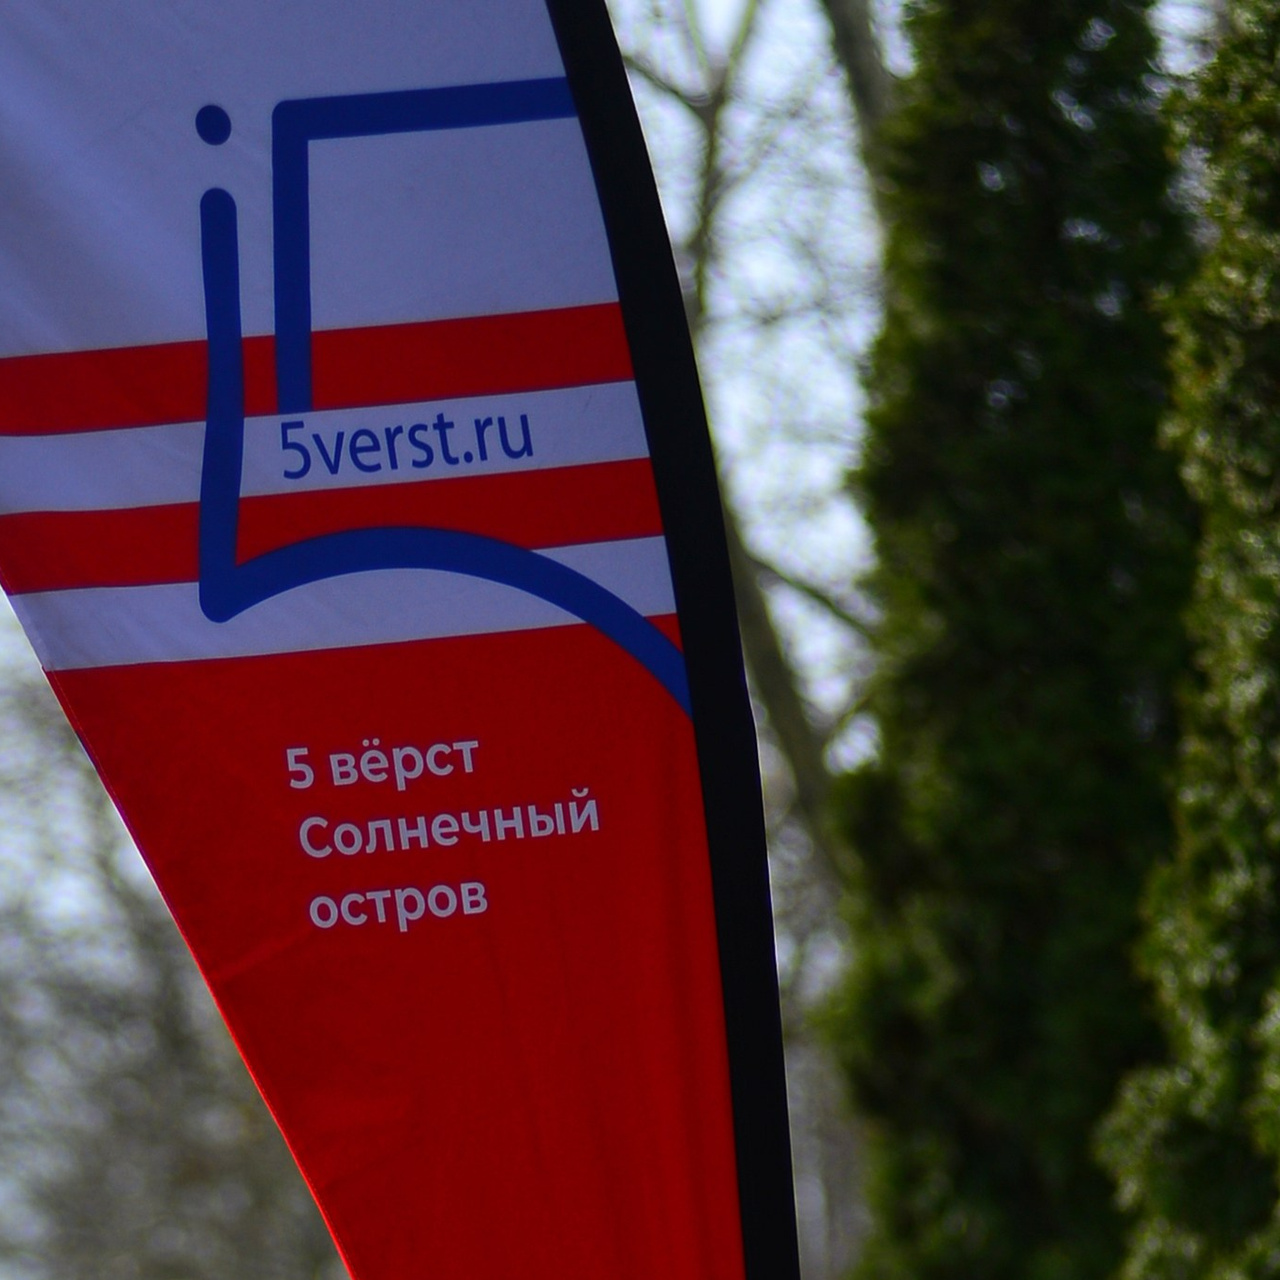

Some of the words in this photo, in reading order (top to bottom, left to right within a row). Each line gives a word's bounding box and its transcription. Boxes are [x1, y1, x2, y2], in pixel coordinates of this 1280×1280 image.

[280, 412, 534, 480] 5verst.ru
[286, 747, 315, 789] 5
[329, 738, 479, 791] вёрст
[299, 788, 600, 858] Солнечный
[309, 882, 488, 932] остров
